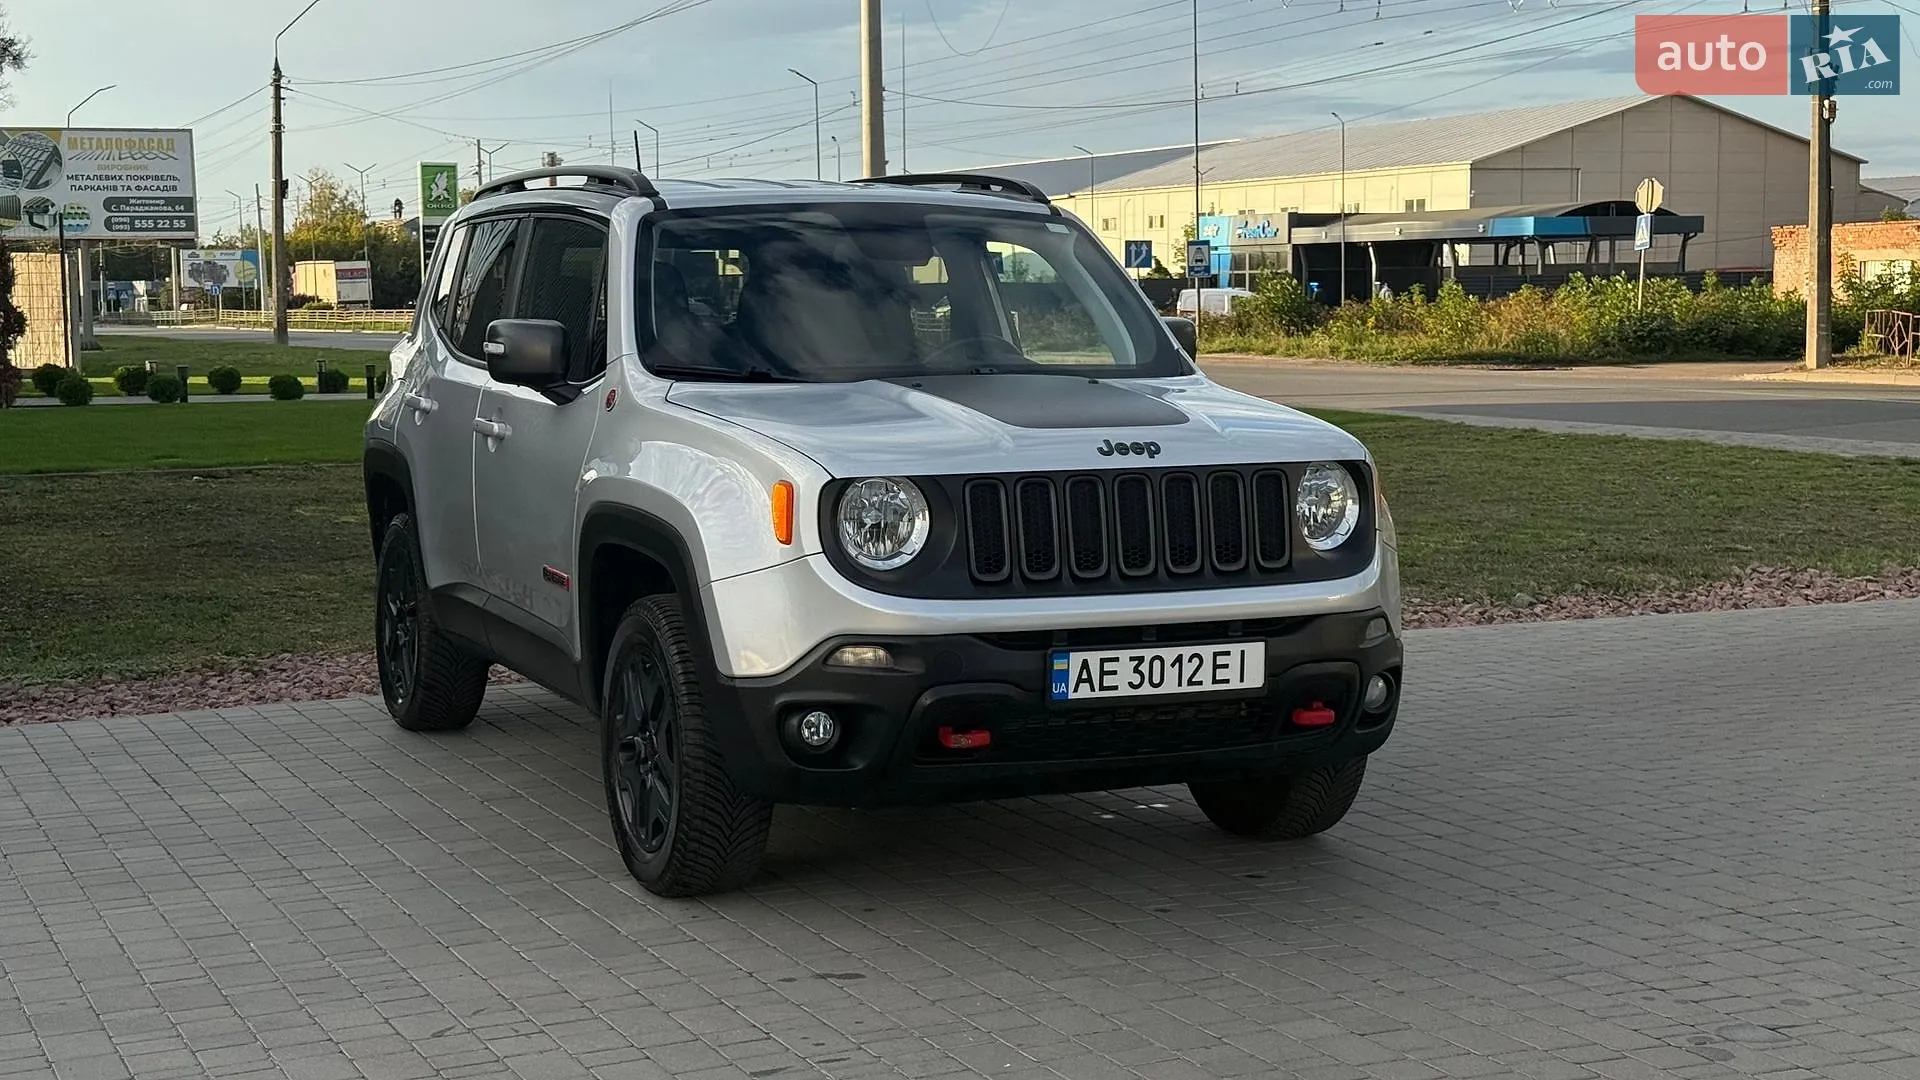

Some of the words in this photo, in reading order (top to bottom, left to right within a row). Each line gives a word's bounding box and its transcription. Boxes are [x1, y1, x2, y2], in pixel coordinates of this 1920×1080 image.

[126, 174, 181, 182] ПОКРІВЕЛЬ,
[70, 184, 118, 192] ПАРКАНІВ
[135, 184, 178, 192] ФАСАДІВ
[134, 219, 154, 228] 555
[157, 219, 170, 228] 22
[173, 219, 186, 228] 55
[1096, 439, 1161, 459] Jeep
[1052, 684, 1067, 694] UA
